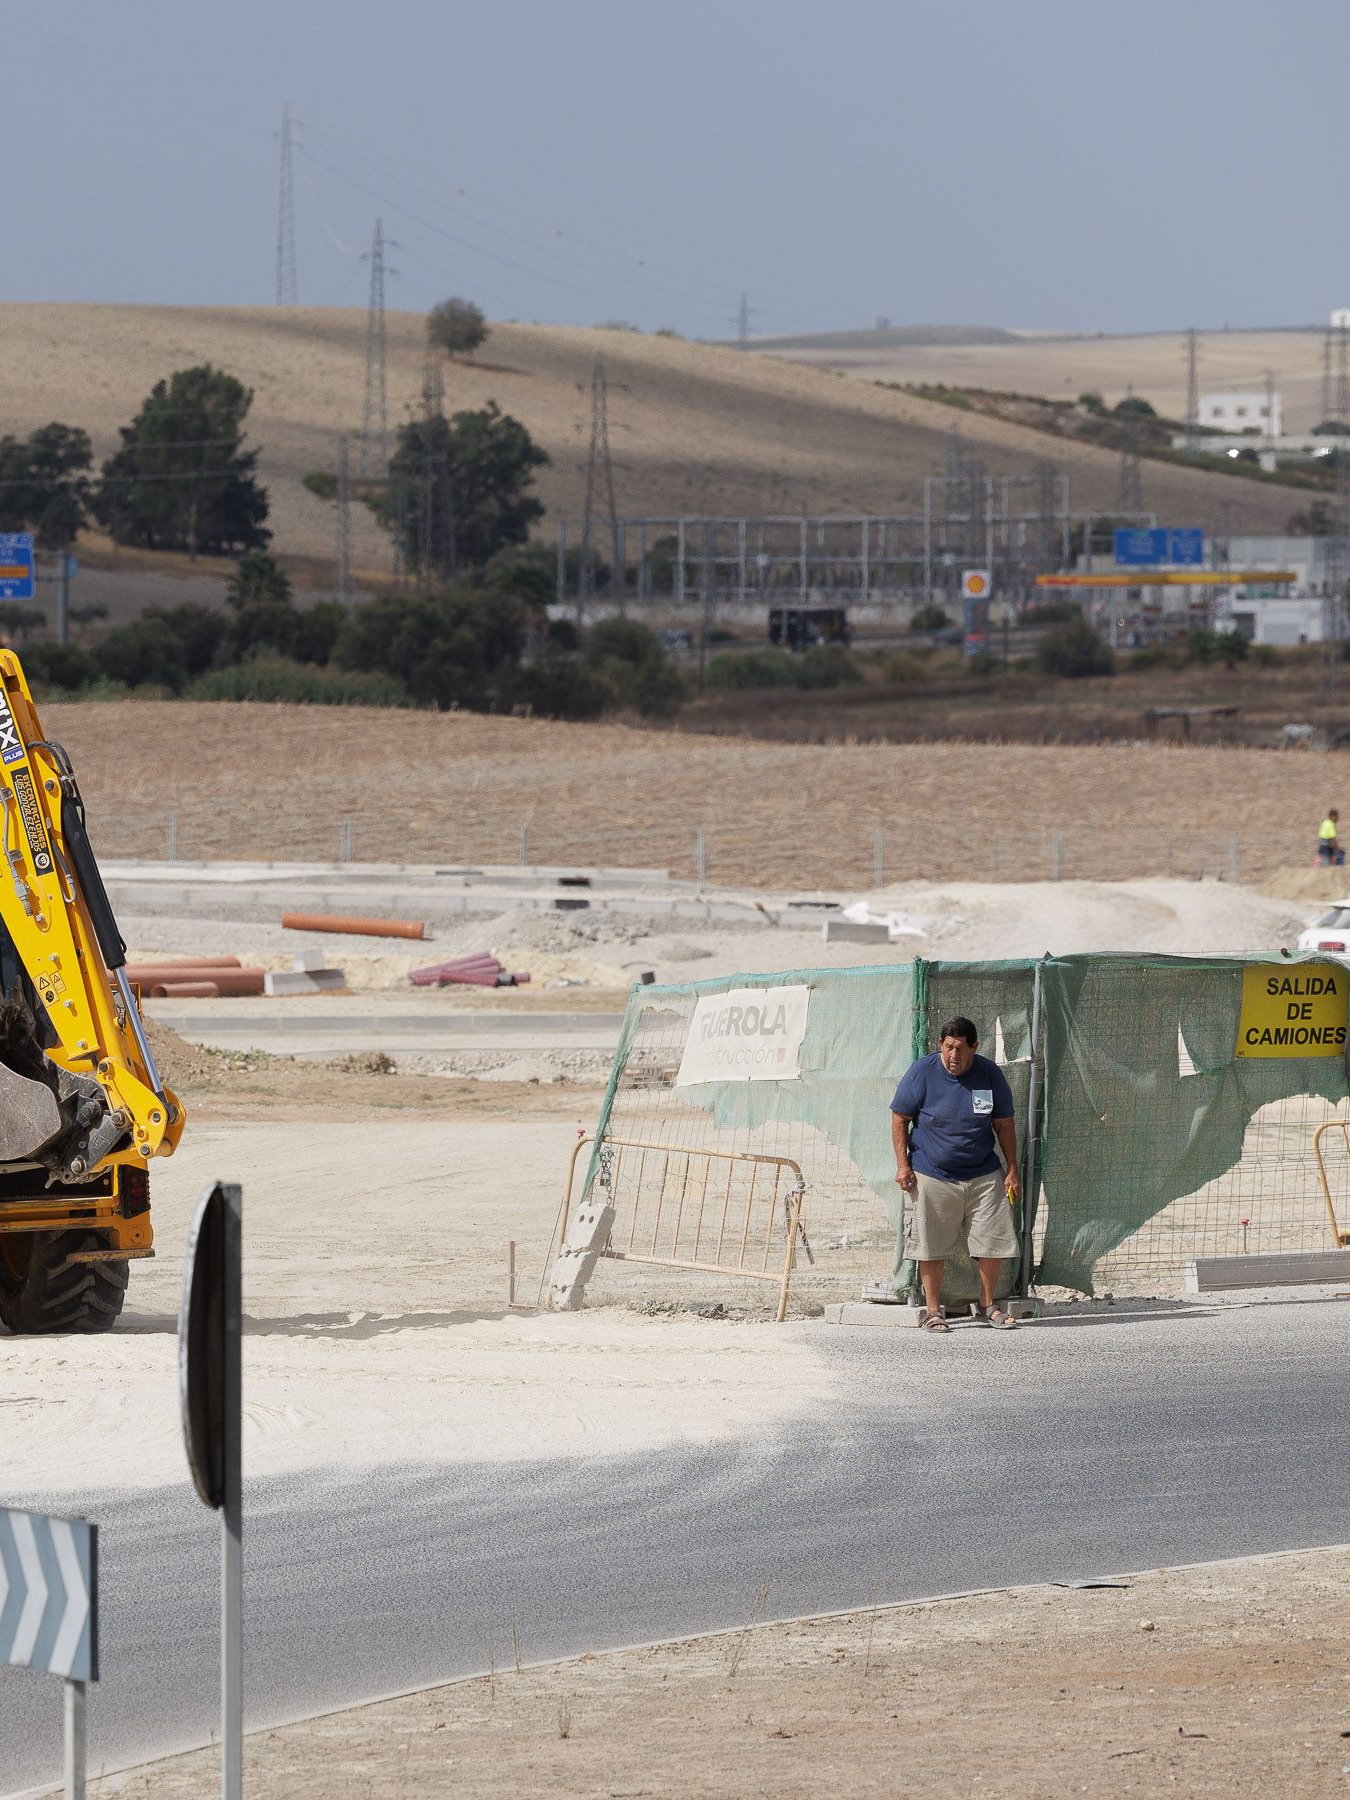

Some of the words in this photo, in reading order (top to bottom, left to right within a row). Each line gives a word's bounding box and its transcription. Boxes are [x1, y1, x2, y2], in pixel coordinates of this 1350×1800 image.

[3, 750, 24, 763] PLUS
[15, 773, 25, 789] LUIS
[29, 830, 40, 852] HIJOS
[22, 774, 46, 848] EXCAVACIONES
[1266, 977, 1337, 996] SALIDA
[1286, 1002, 1314, 1020] DE
[1245, 1026, 1347, 1046] CAMIONES
